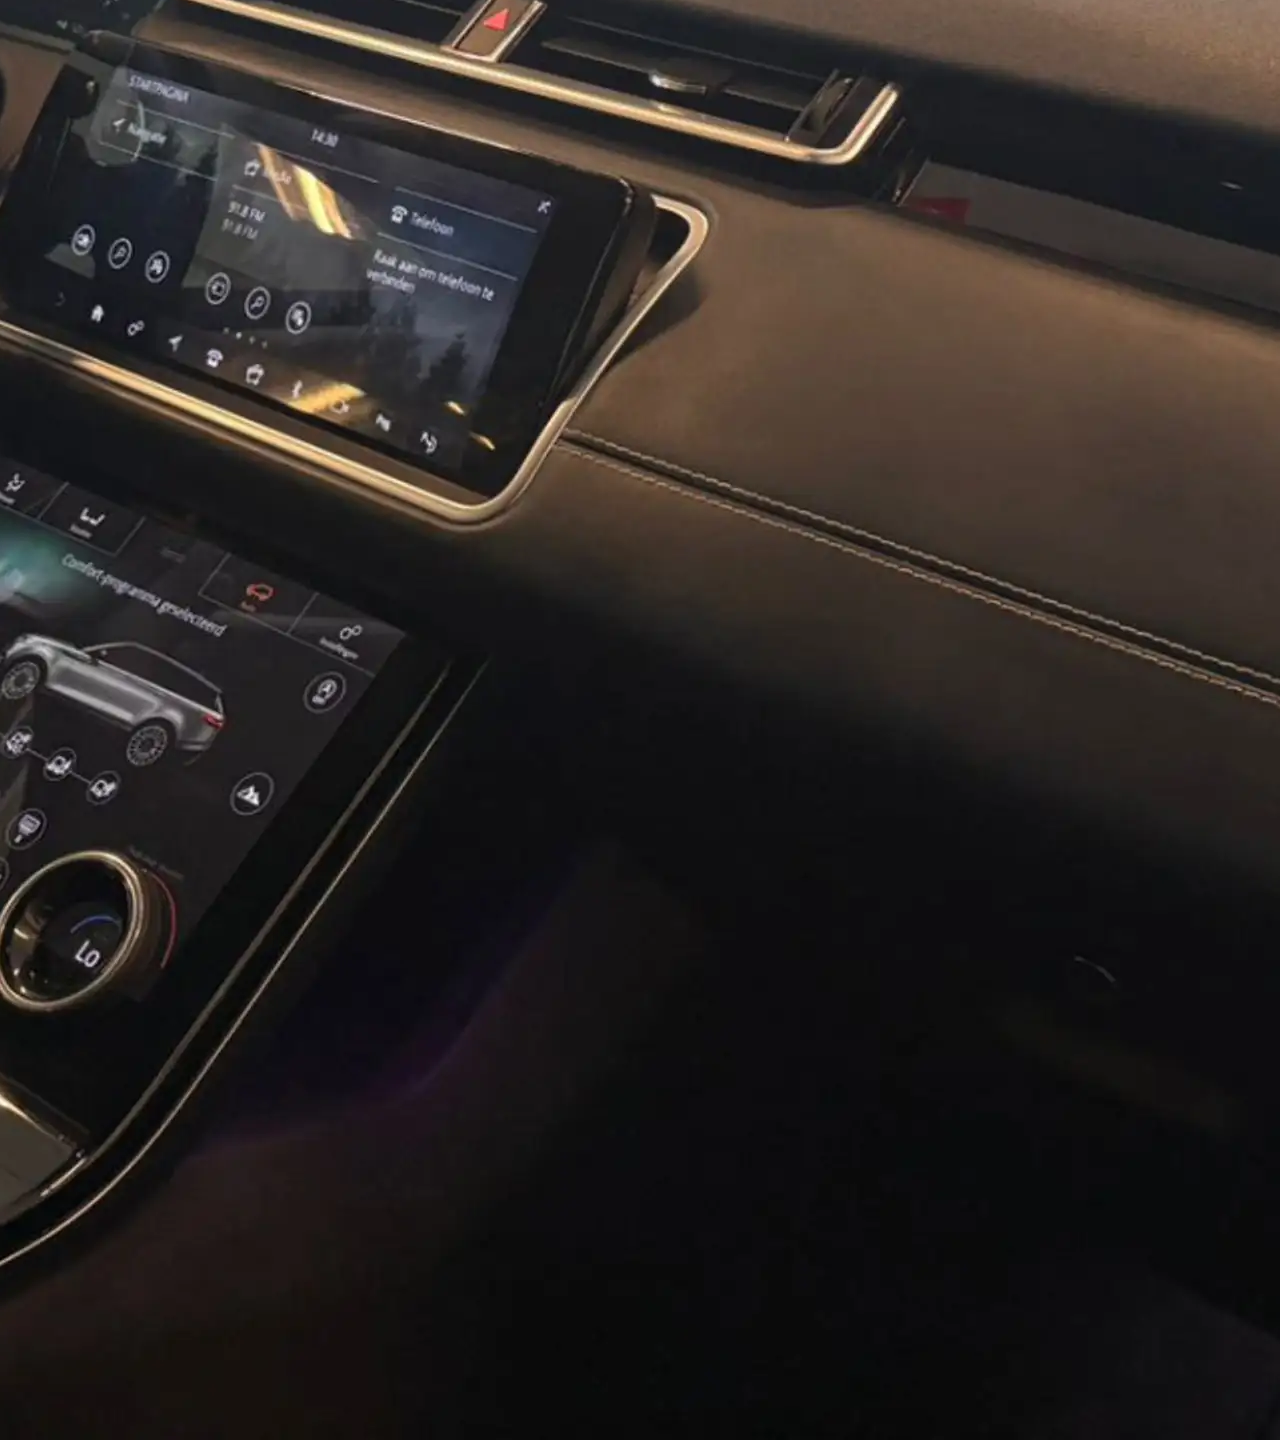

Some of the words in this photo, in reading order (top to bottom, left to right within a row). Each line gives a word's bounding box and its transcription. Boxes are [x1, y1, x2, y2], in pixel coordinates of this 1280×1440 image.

[249, 209, 266, 223] FM
[410, 211, 455, 237] Telefoon
[418, 265, 437, 281] om
[437, 271, 481, 296] telefoon
[481, 285, 496, 302] te
[62, 553, 161, 608] Comfort-programma
[156, 598, 228, 638] geselecteerd
